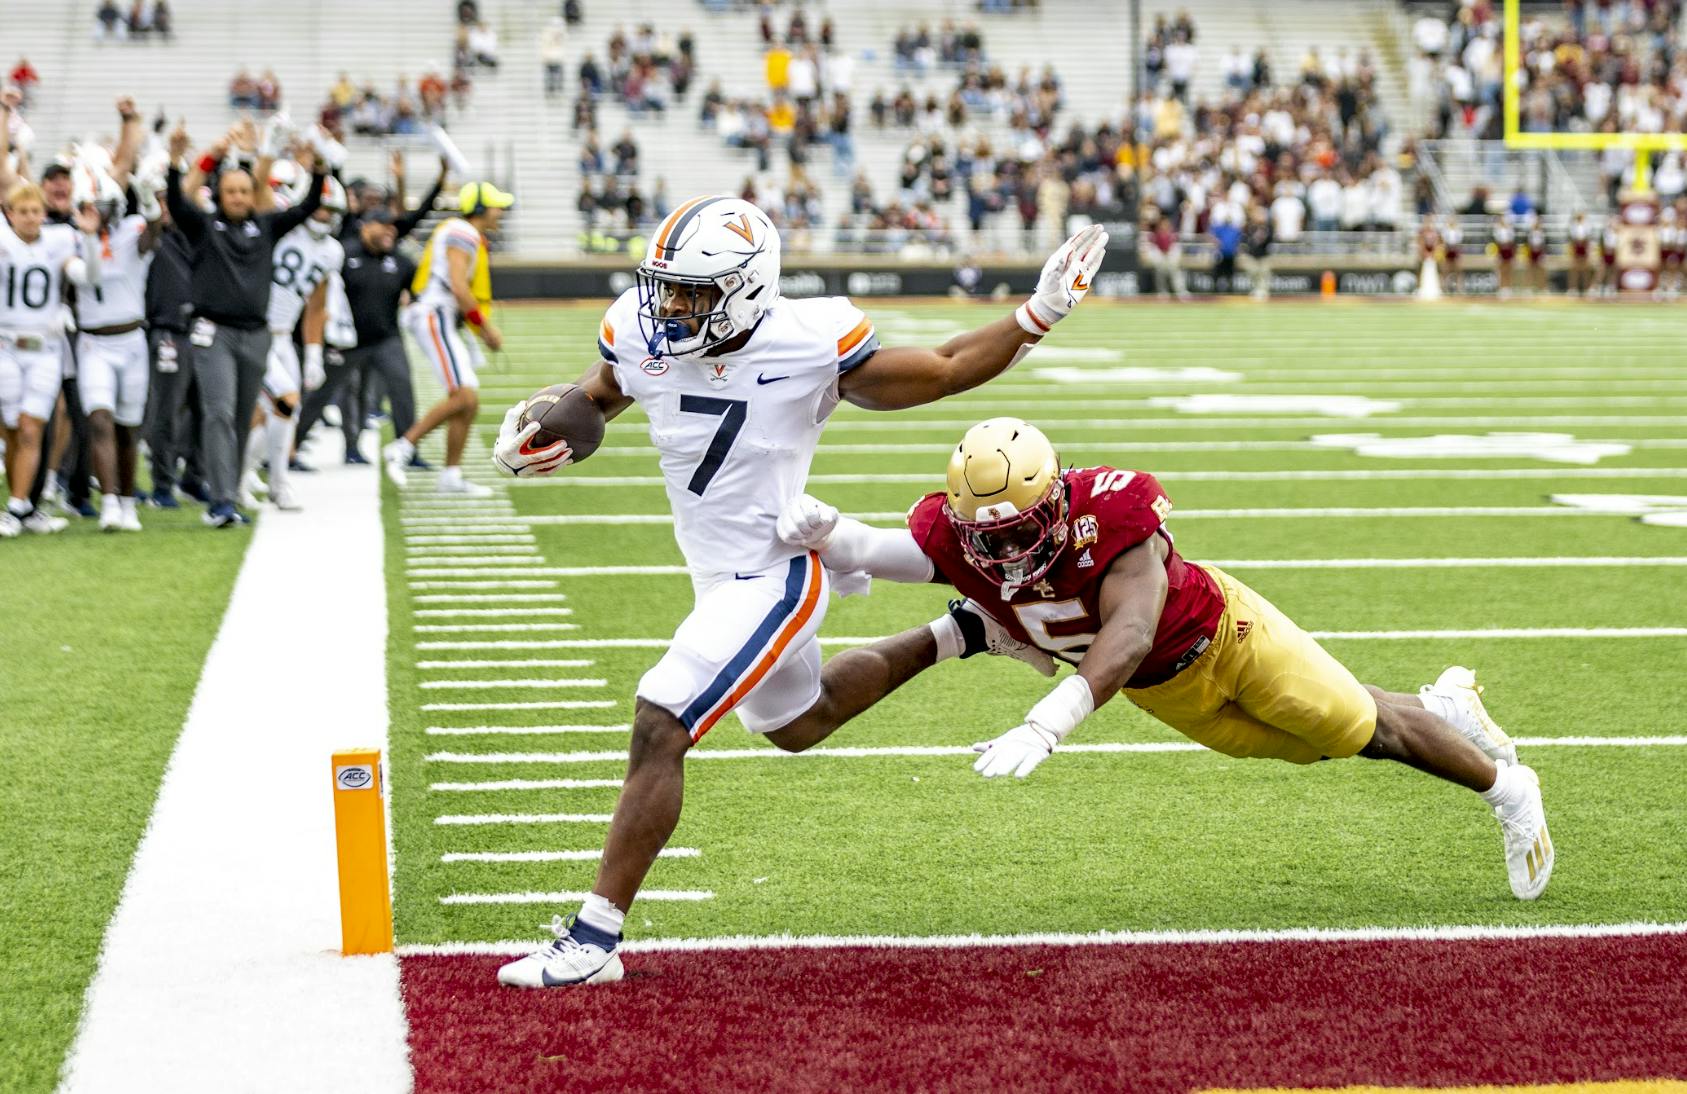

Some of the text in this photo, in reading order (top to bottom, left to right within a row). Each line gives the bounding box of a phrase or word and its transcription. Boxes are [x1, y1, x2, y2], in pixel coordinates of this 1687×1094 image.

[6, 265, 50, 309] 10
[271, 247, 324, 297] 85
[644, 361, 665, 369] ACC
[680, 394, 748, 497] 7
[1090, 470, 1137, 498] 5
[1072, 515, 1098, 540] 125
[1011, 597, 1098, 663] 5
[344, 772, 366, 780] ACC
